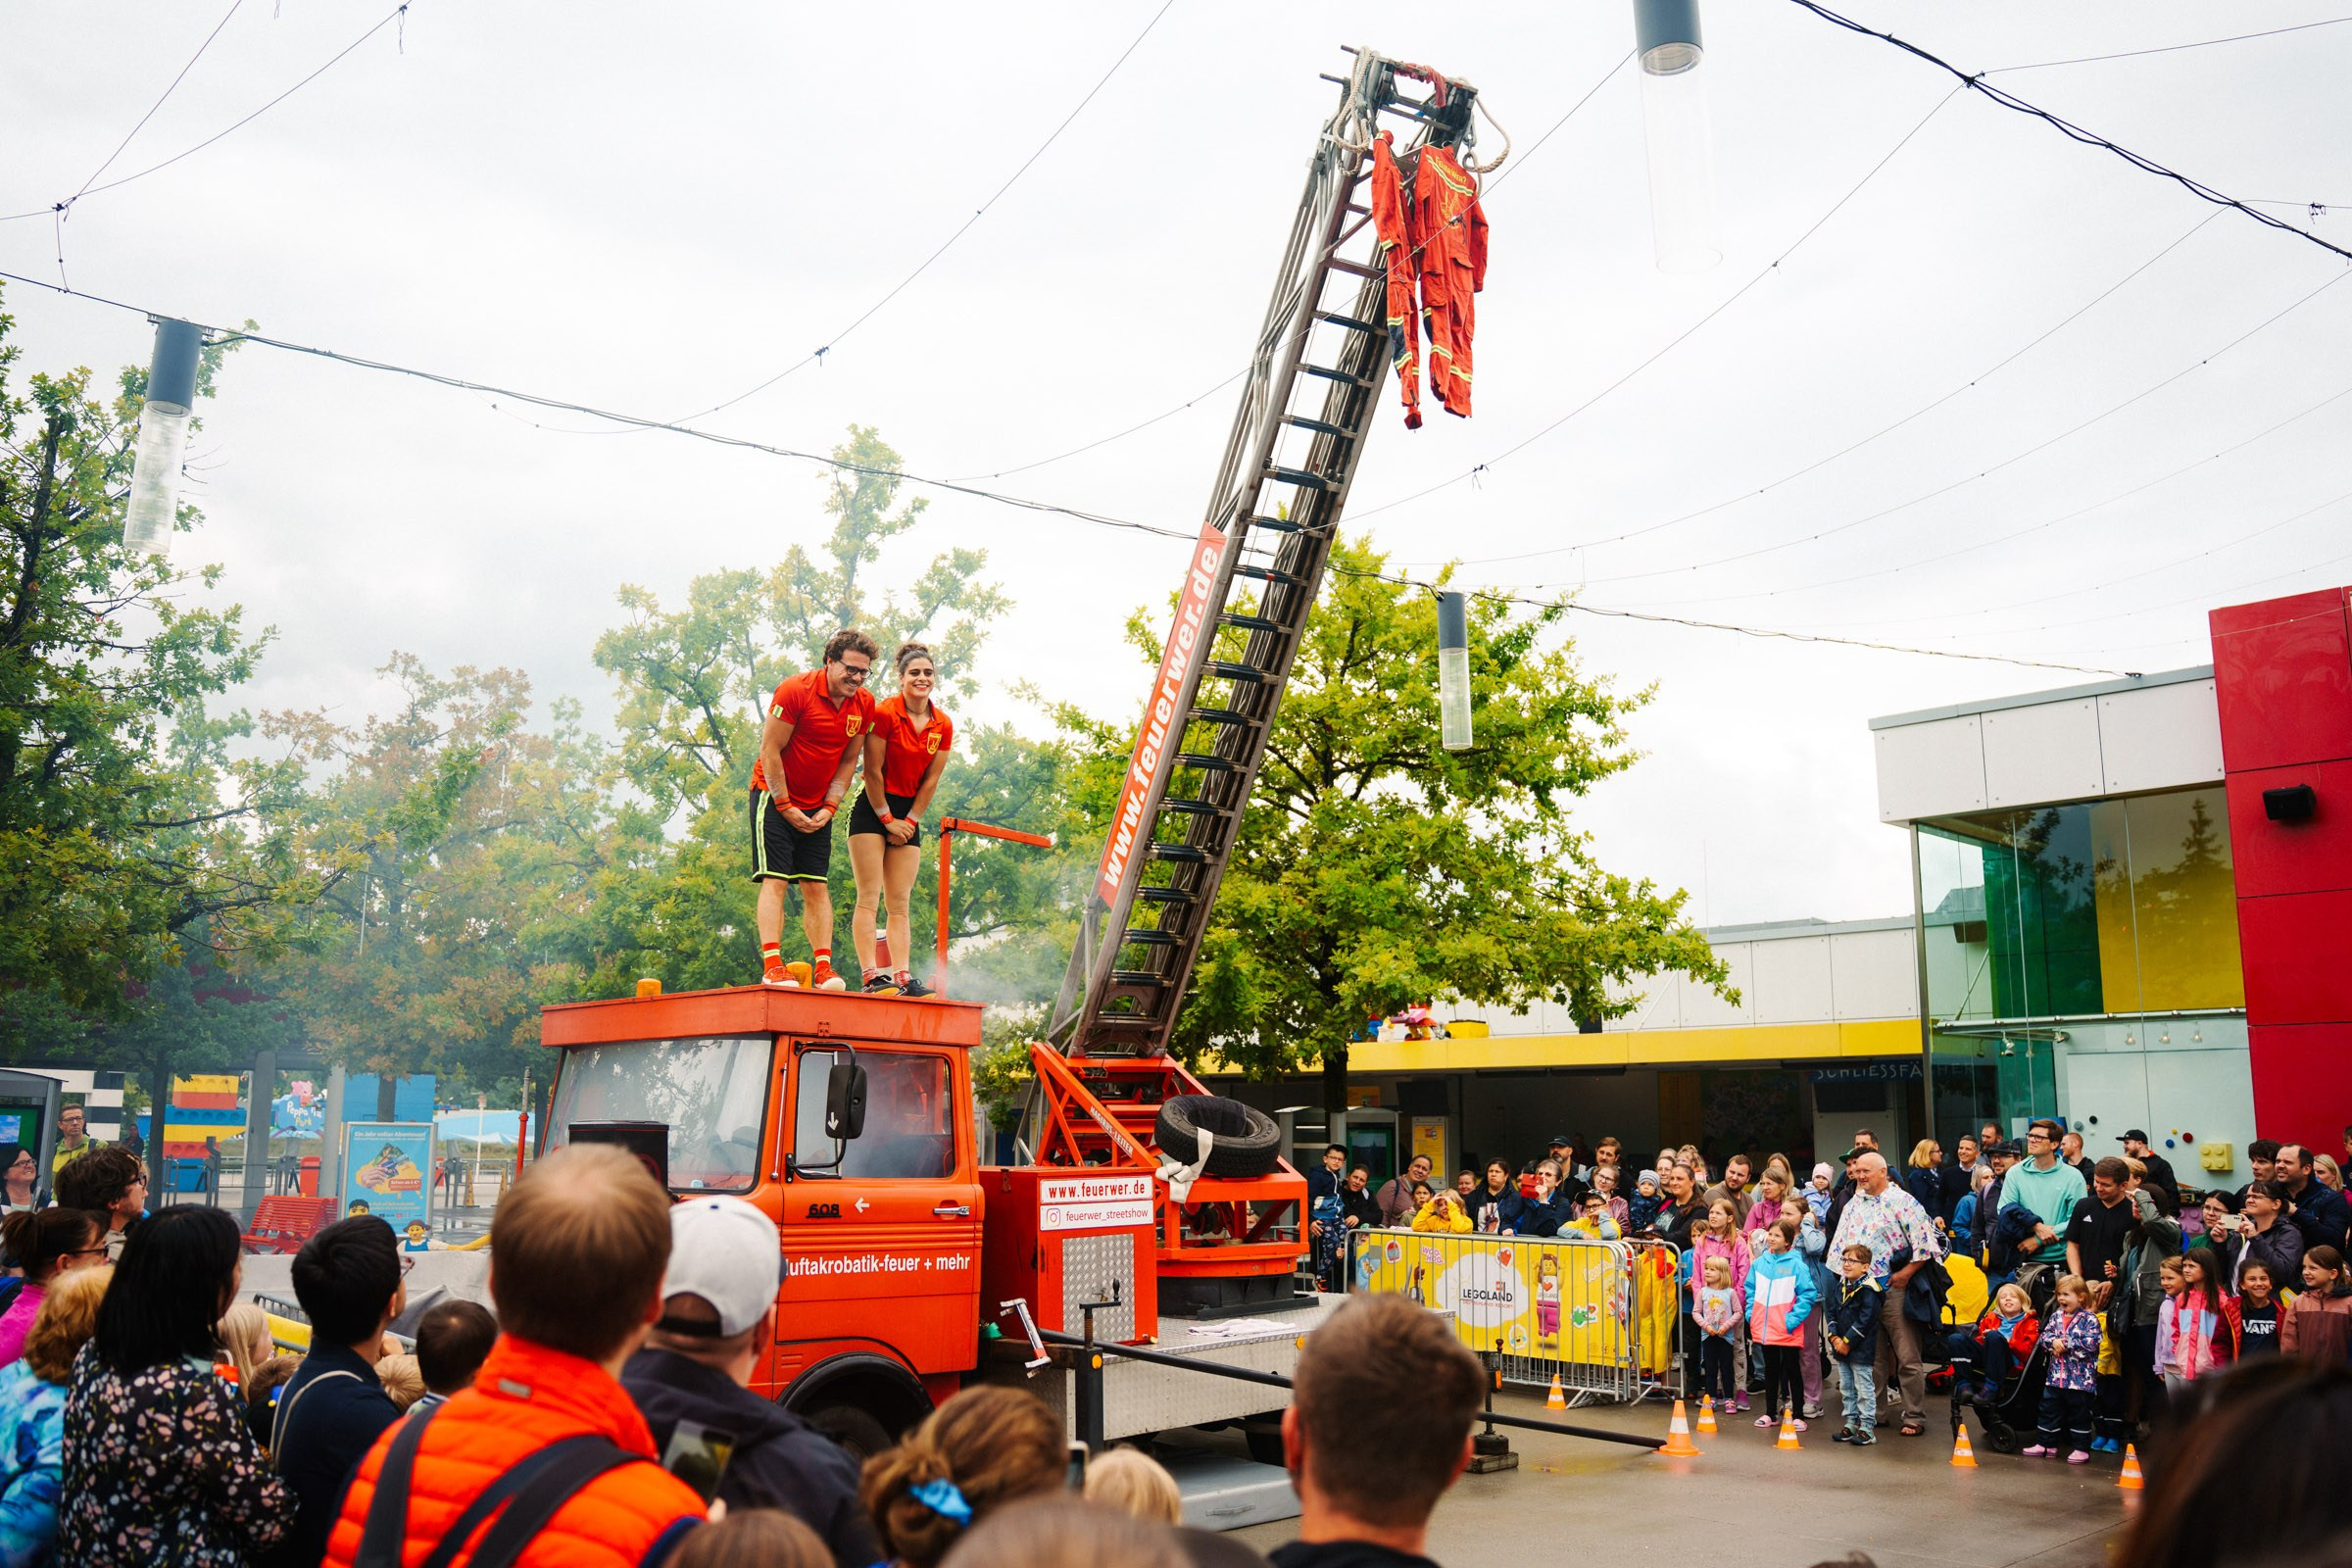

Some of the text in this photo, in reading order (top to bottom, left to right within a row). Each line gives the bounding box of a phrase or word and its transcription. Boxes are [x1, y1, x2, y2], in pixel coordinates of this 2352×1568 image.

[1103, 546, 1218, 888] www.feuerwer.de
[1049, 1180, 1146, 1199] www.feuerwer.de
[808, 1203, 840, 1217] 608
[1065, 1208, 1149, 1222] feuerwer_streetshow
[936, 1253, 970, 1270] mehr
[1463, 1286, 1513, 1302] LEGOLAND
[2242, 1319, 2277, 1335] VANS
